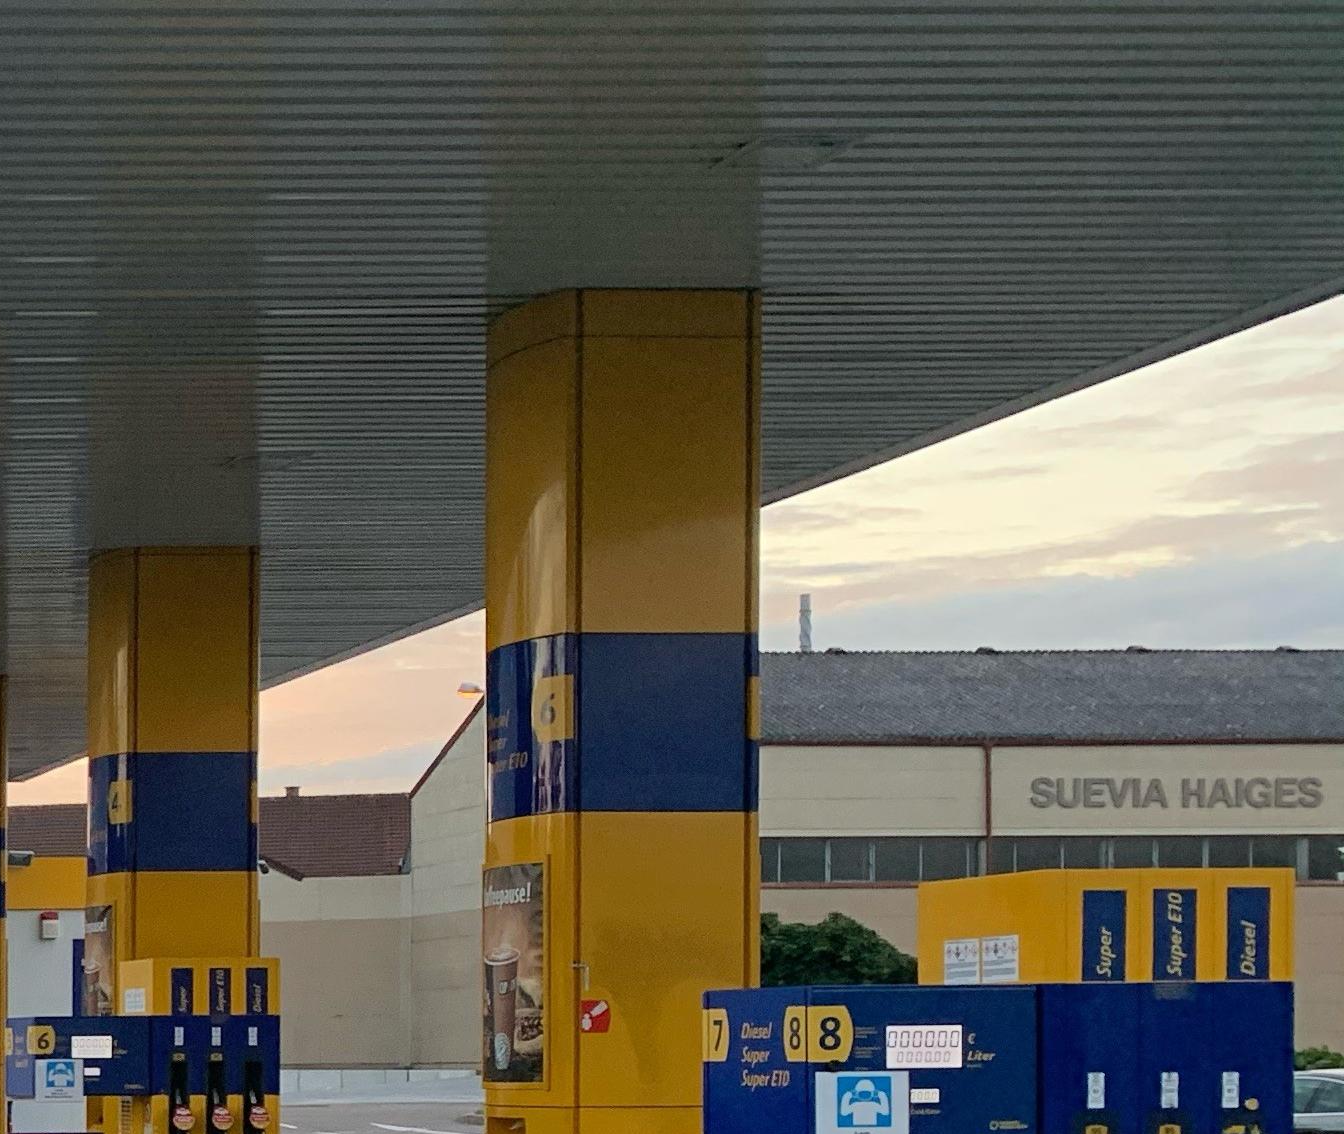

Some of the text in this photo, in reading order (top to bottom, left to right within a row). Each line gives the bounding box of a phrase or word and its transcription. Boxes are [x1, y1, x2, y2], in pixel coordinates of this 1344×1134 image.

[540, 692, 556, 725] 6
[1030, 777, 1324, 809] SUEVIA HAIGES
[1166, 891, 1188, 977] Super E10
[1239, 919, 1257, 977] Diesel
[1097, 925, 1113, 978] Super
[37, 1032, 50, 1050] 6
[712, 1020, 723, 1051] 7
[741, 1022, 772, 1040] Diesel
[789, 1016, 801, 1050] 8
[819, 1016, 842, 1053] 8
[741, 1045, 770, 1064] Super
[967, 1050, 996, 1062] Liter
[741, 1069, 790, 1092] Super E10
